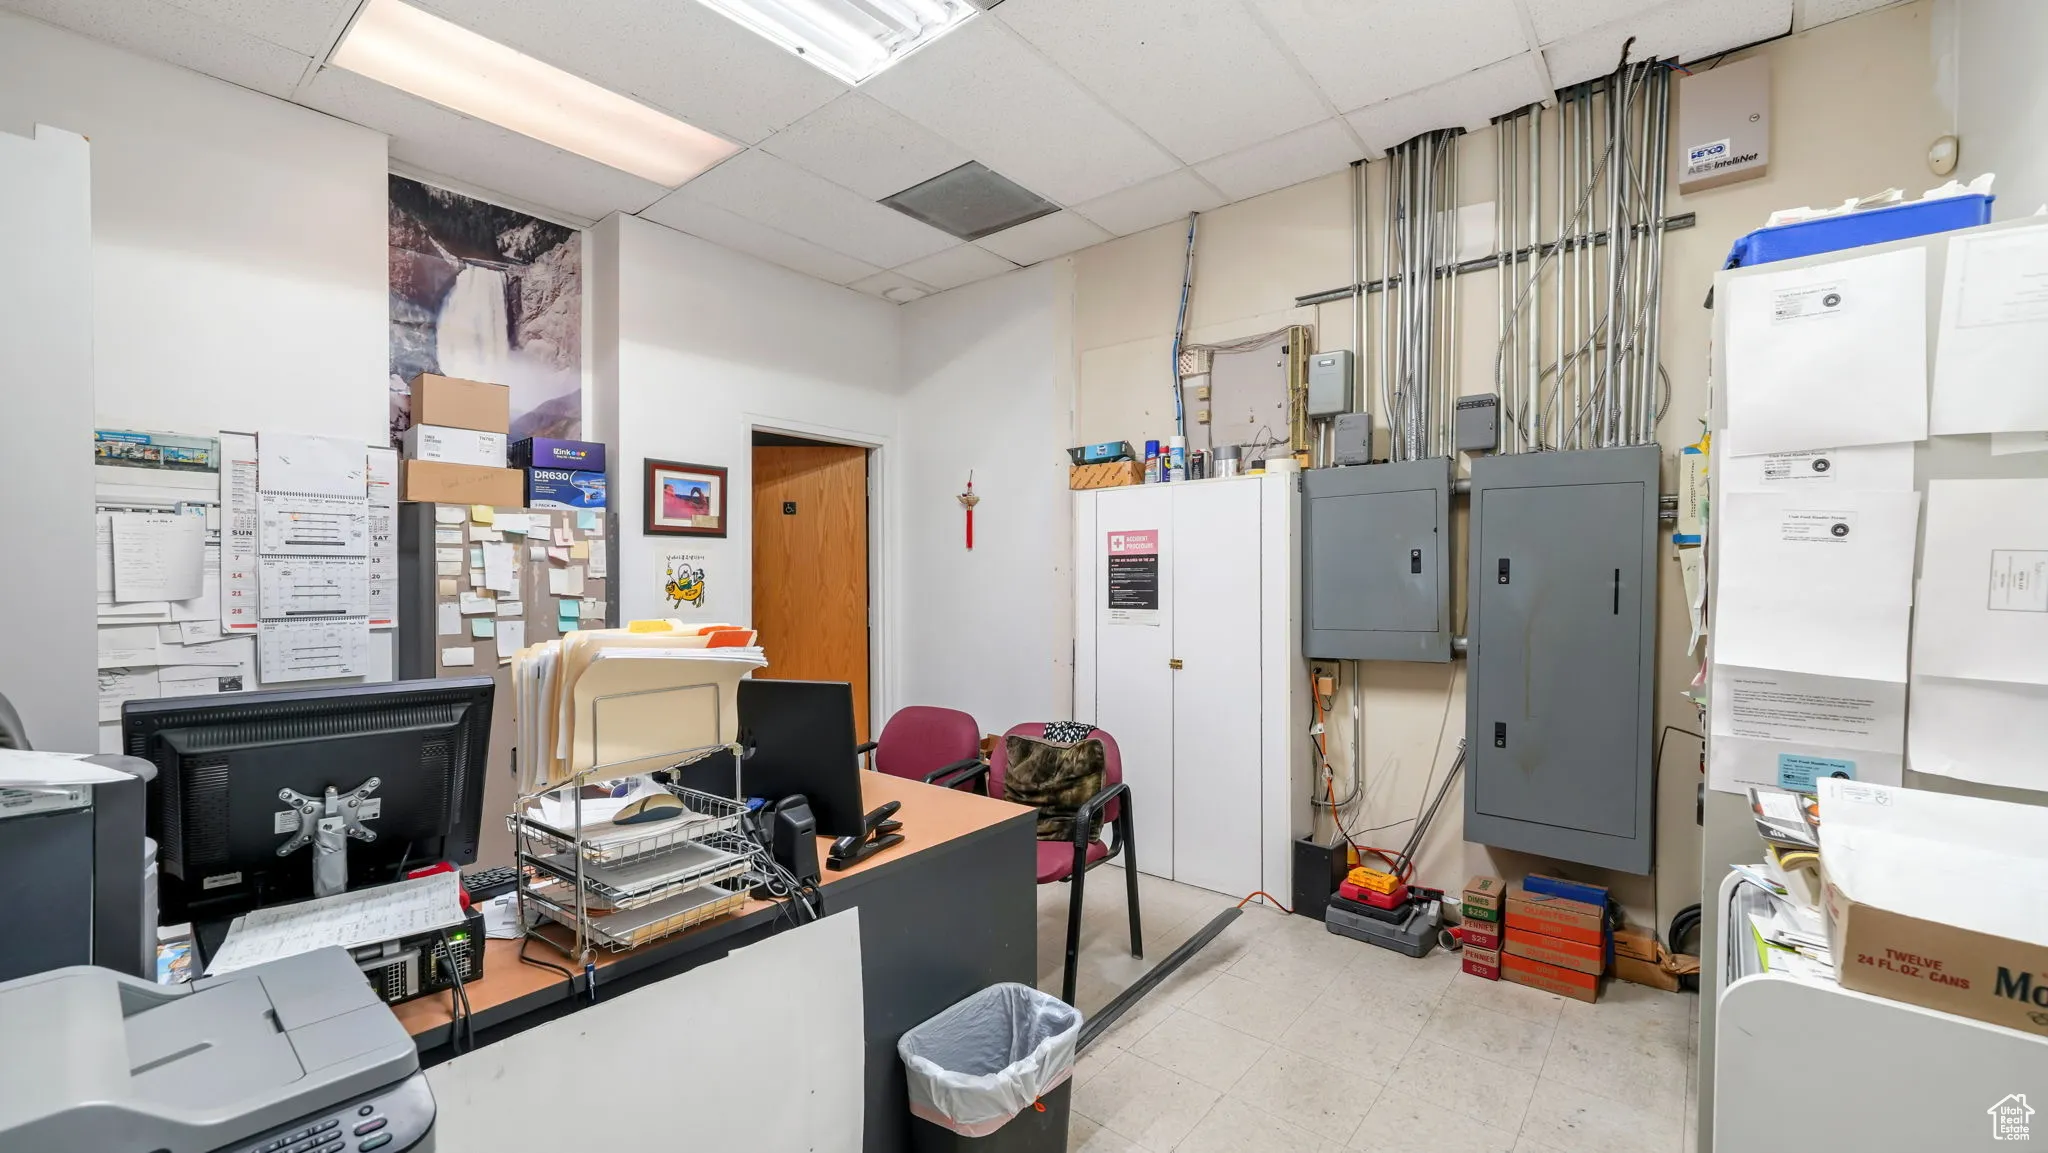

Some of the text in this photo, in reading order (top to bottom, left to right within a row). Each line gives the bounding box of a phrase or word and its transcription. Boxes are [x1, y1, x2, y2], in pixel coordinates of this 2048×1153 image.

[1688, 163, 1711, 175] AES
[1714, 153, 1759, 169] IntelliNet
[534, 470, 569, 481] DR630
[1467, 895, 1489, 906] DIMES
[1468, 909, 1489, 918] $250
[1464, 920, 1494, 933] PENNIES
[1471, 934, 1487, 943] $25
[1465, 949, 1495, 964] PENNIES
[1885, 948, 1943, 971] TWELVE
[1471, 964, 1488, 975] $25
[1857, 953, 1874, 966] 24
[1929, 971, 1971, 990] CANS
